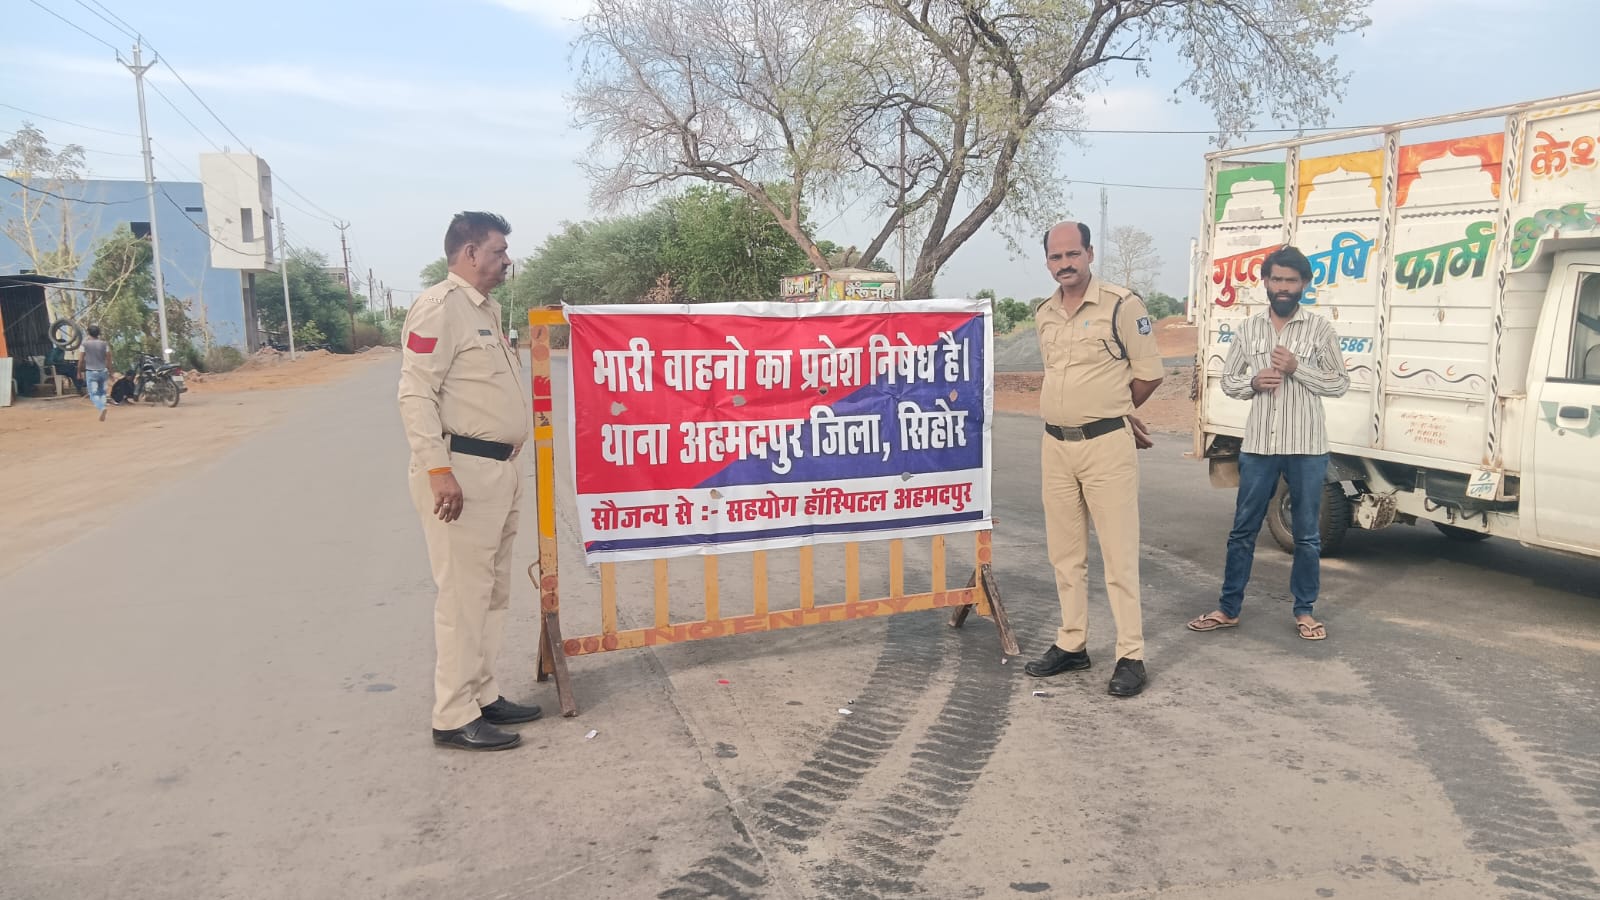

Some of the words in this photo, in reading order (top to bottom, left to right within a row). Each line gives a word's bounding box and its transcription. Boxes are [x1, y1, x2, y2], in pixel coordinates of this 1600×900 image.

[1394, 220, 1496, 290] फार्म
[592, 337, 655, 392] भारी
[661, 335, 749, 392] वाहनो
[754, 349, 793, 390] का
[799, 334, 863, 391] प्रवेश
[868, 332, 938, 385] निषेध
[1339, 337, 1373, 353] 5861
[601, 423, 671, 466] थाना
[679, 418, 804, 475] अहमदपुर
[809, 404, 891, 462] जिला,
[898, 398, 969, 451] सिहोर
[591, 500, 669, 530] सौजन्य
[675, 495, 694, 525] से
[726, 490, 799, 522] सहयोग
[804, 487, 888, 515] हॉस्पिटल
[893, 482, 973, 512] अहमदपुर
